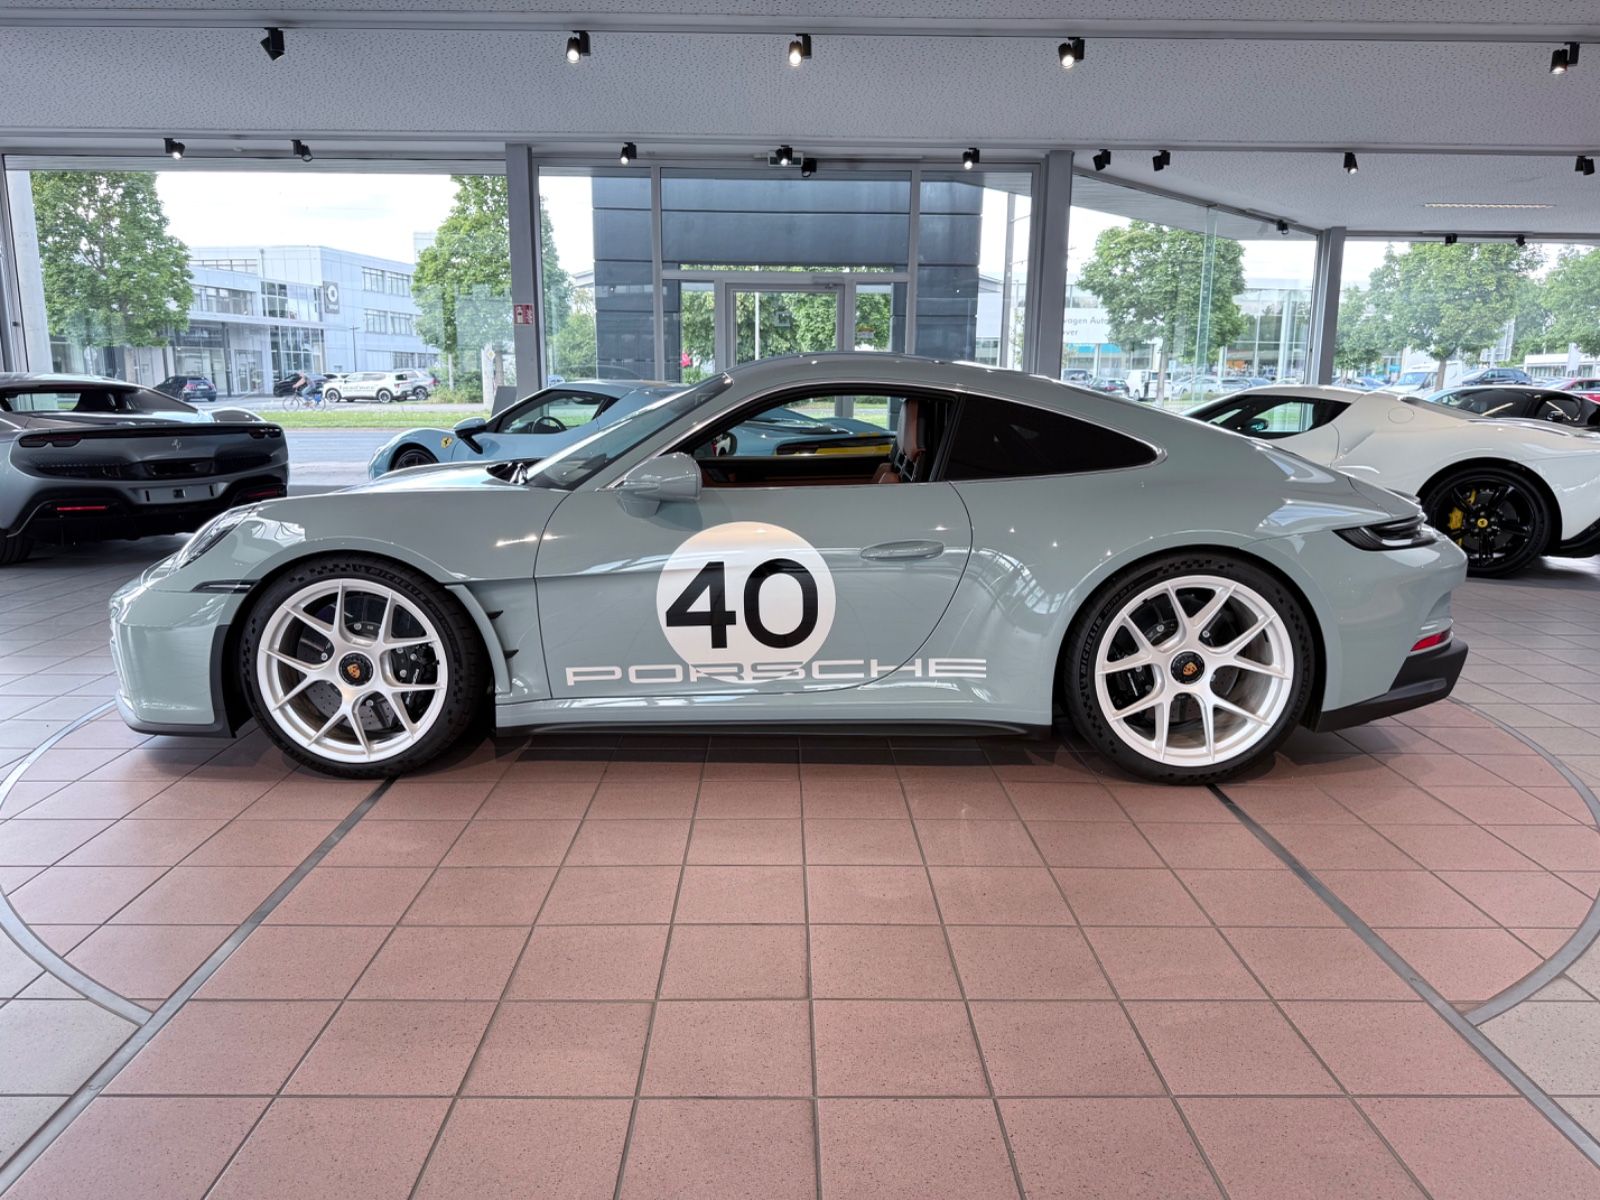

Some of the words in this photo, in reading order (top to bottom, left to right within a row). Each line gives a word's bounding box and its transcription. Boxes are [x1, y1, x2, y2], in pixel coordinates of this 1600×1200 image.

[665, 557, 819, 650] 40
[565, 658, 987, 686] PORSCHE
[1079, 615, 1104, 676] MICHELIN
